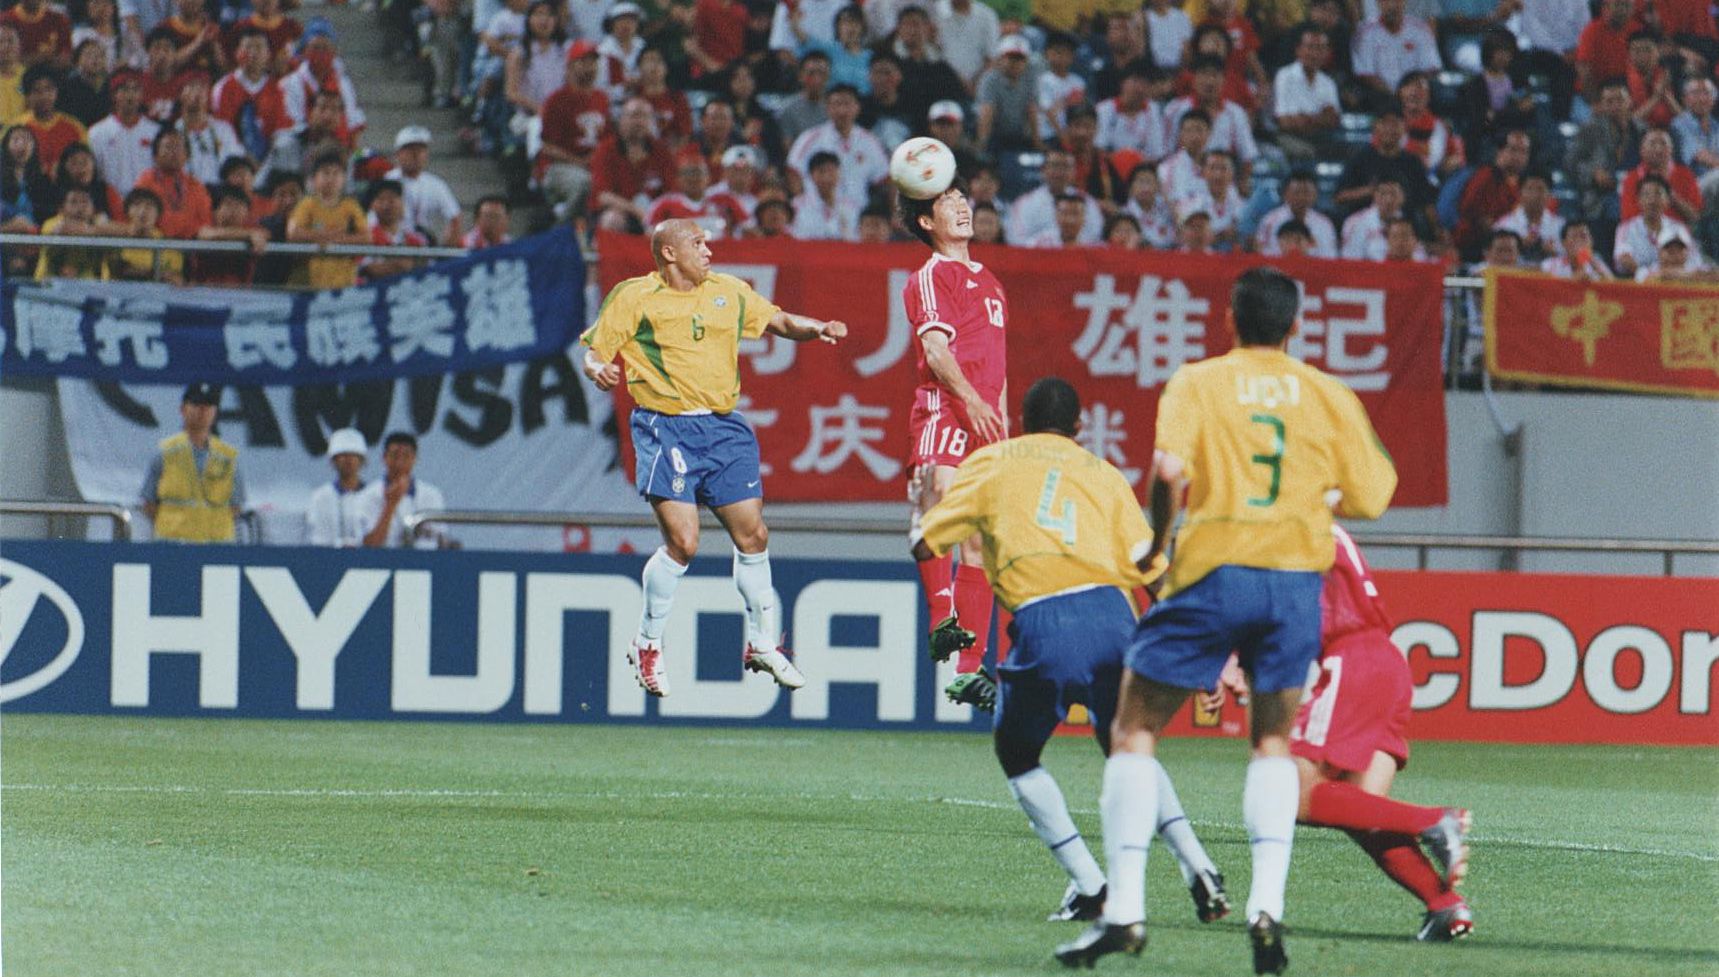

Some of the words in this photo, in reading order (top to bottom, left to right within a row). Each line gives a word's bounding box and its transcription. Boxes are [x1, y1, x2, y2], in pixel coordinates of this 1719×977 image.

[692, 313, 705, 341] 6
[93, 354, 591, 458] AMISA
[938, 426, 967, 456] 18
[1248, 415, 1284, 506] 3
[1036, 468, 1076, 545] 4
[1389, 609, 1719, 715] cDo
